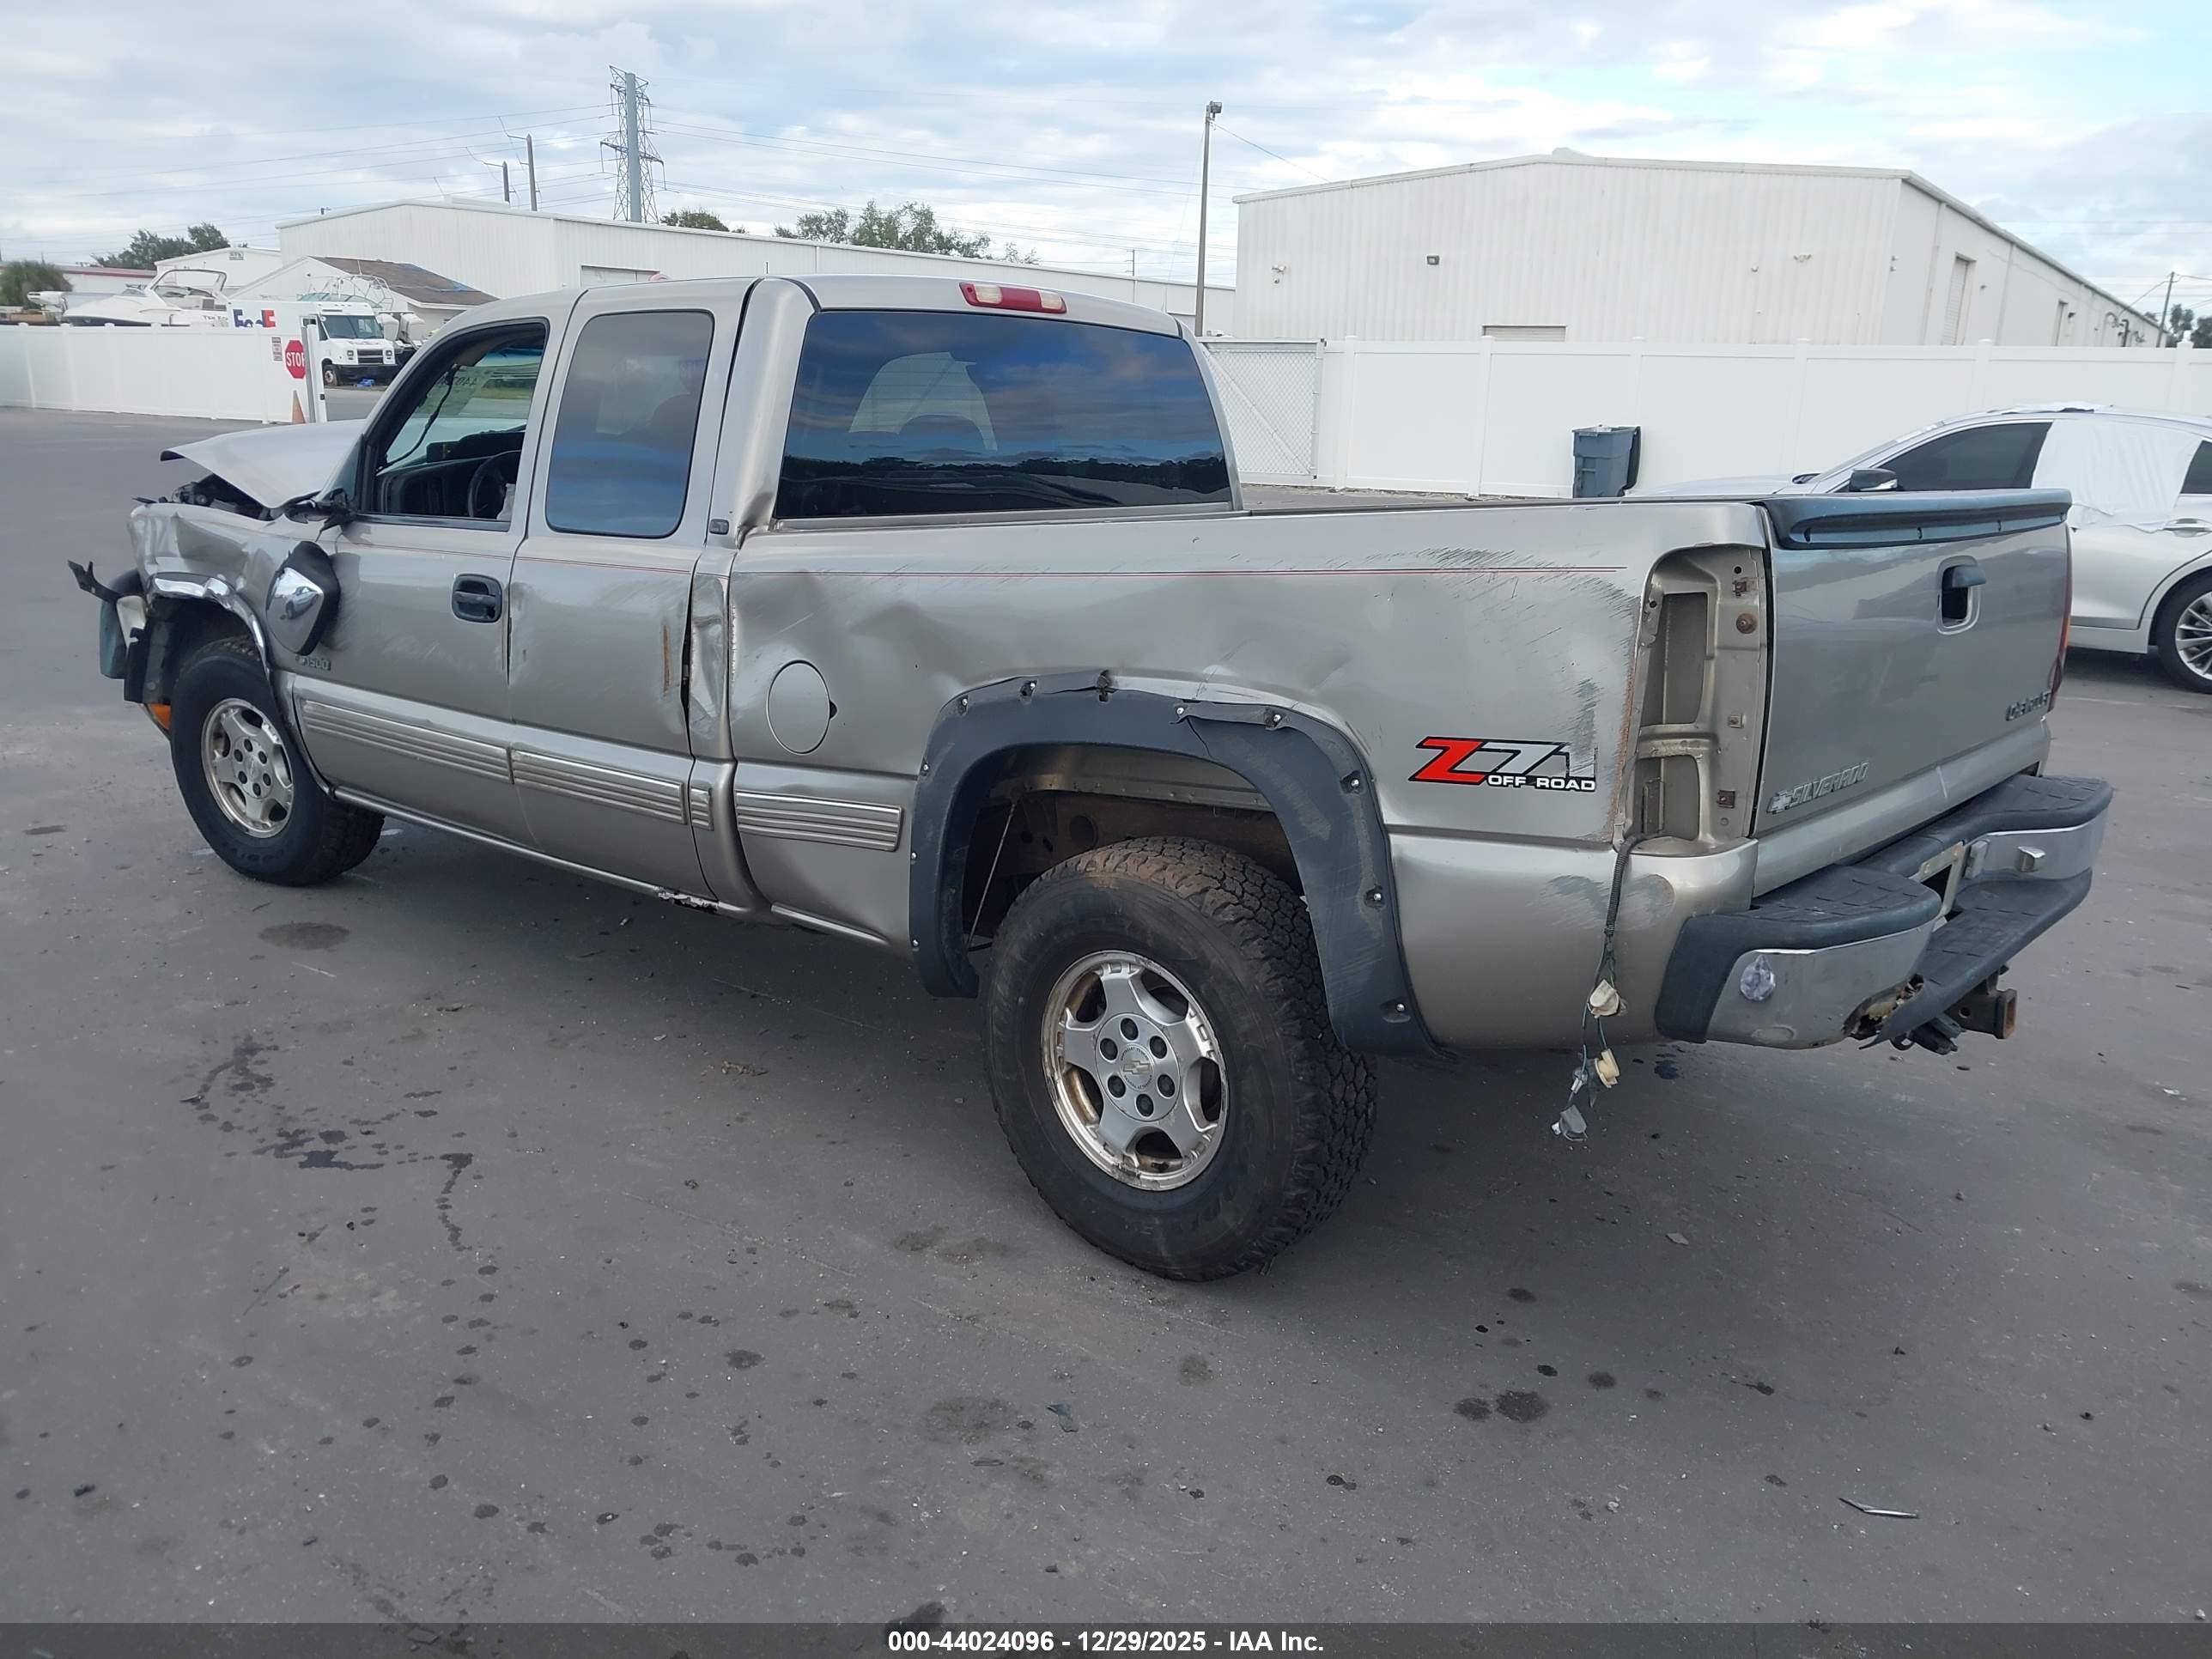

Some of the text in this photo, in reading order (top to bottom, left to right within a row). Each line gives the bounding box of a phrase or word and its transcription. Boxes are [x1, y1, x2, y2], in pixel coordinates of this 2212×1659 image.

[1408, 736, 1595, 785] Z71
[1486, 774, 1596, 792] OFF ROAD
[1790, 762, 1869, 807] SILVERADO
